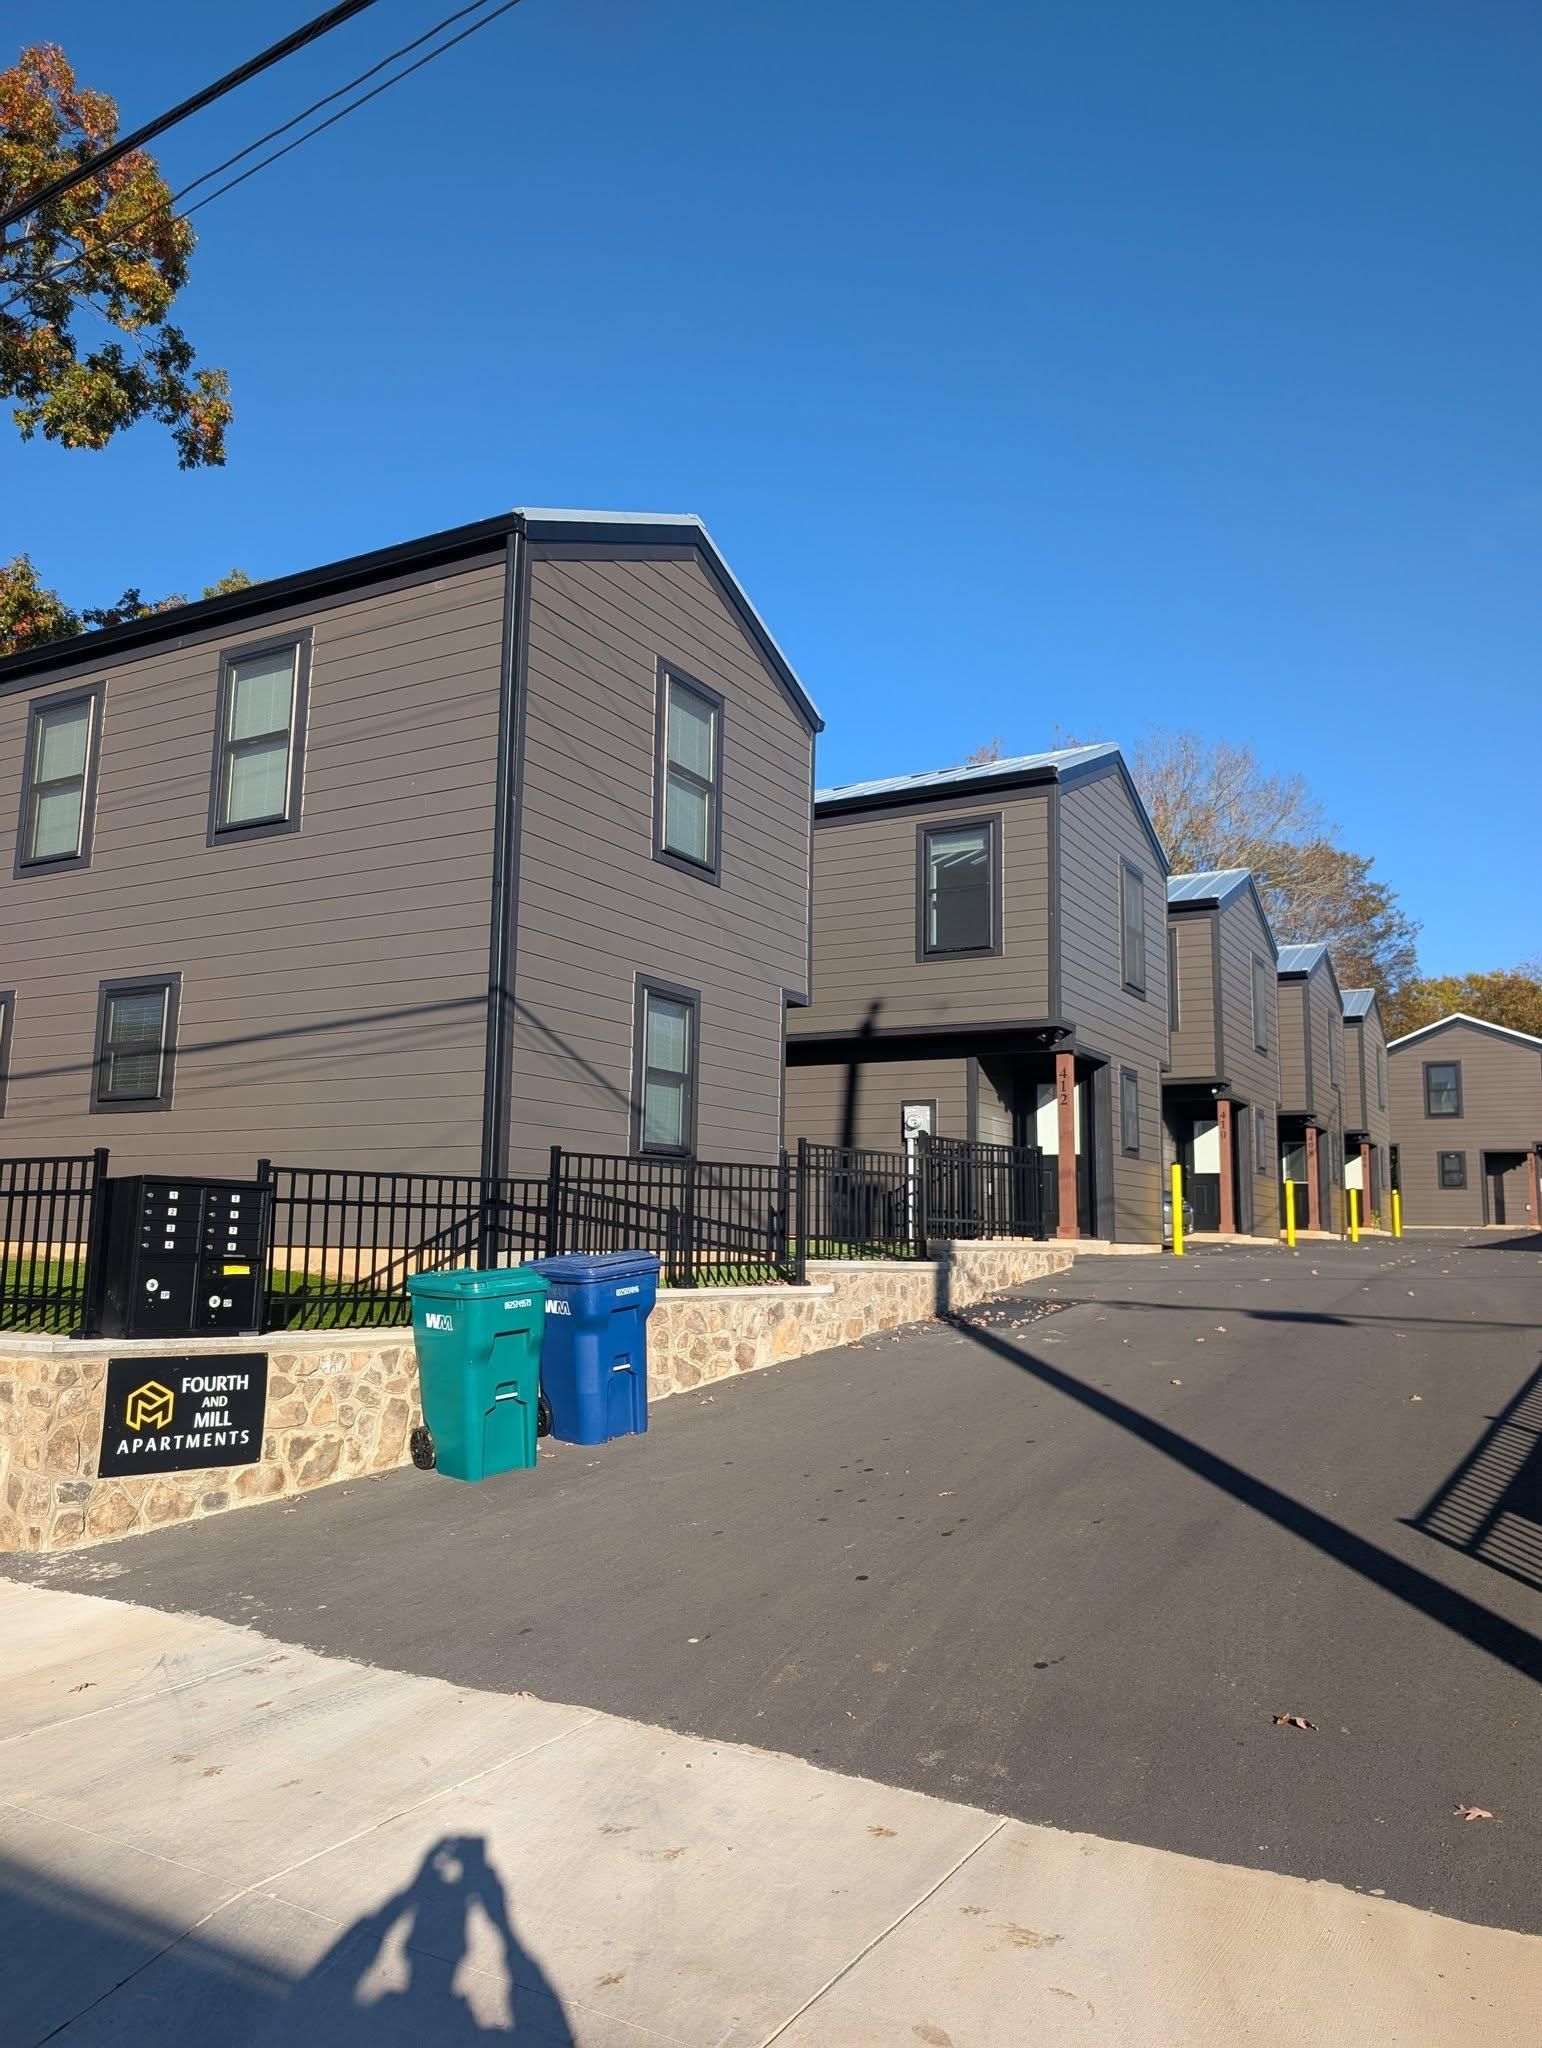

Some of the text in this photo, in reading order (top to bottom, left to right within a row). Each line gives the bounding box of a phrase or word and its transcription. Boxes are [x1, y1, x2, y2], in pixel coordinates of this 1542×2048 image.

[1058, 1066, 1068, 1106] 412
[425, 1312, 453, 1331] WM
[181, 1374, 249, 1394] FOURTH
[201, 1395, 228, 1408] AND
[193, 1410, 232, 1429] MILL
[116, 1429, 250, 1455] APARTMENTS
